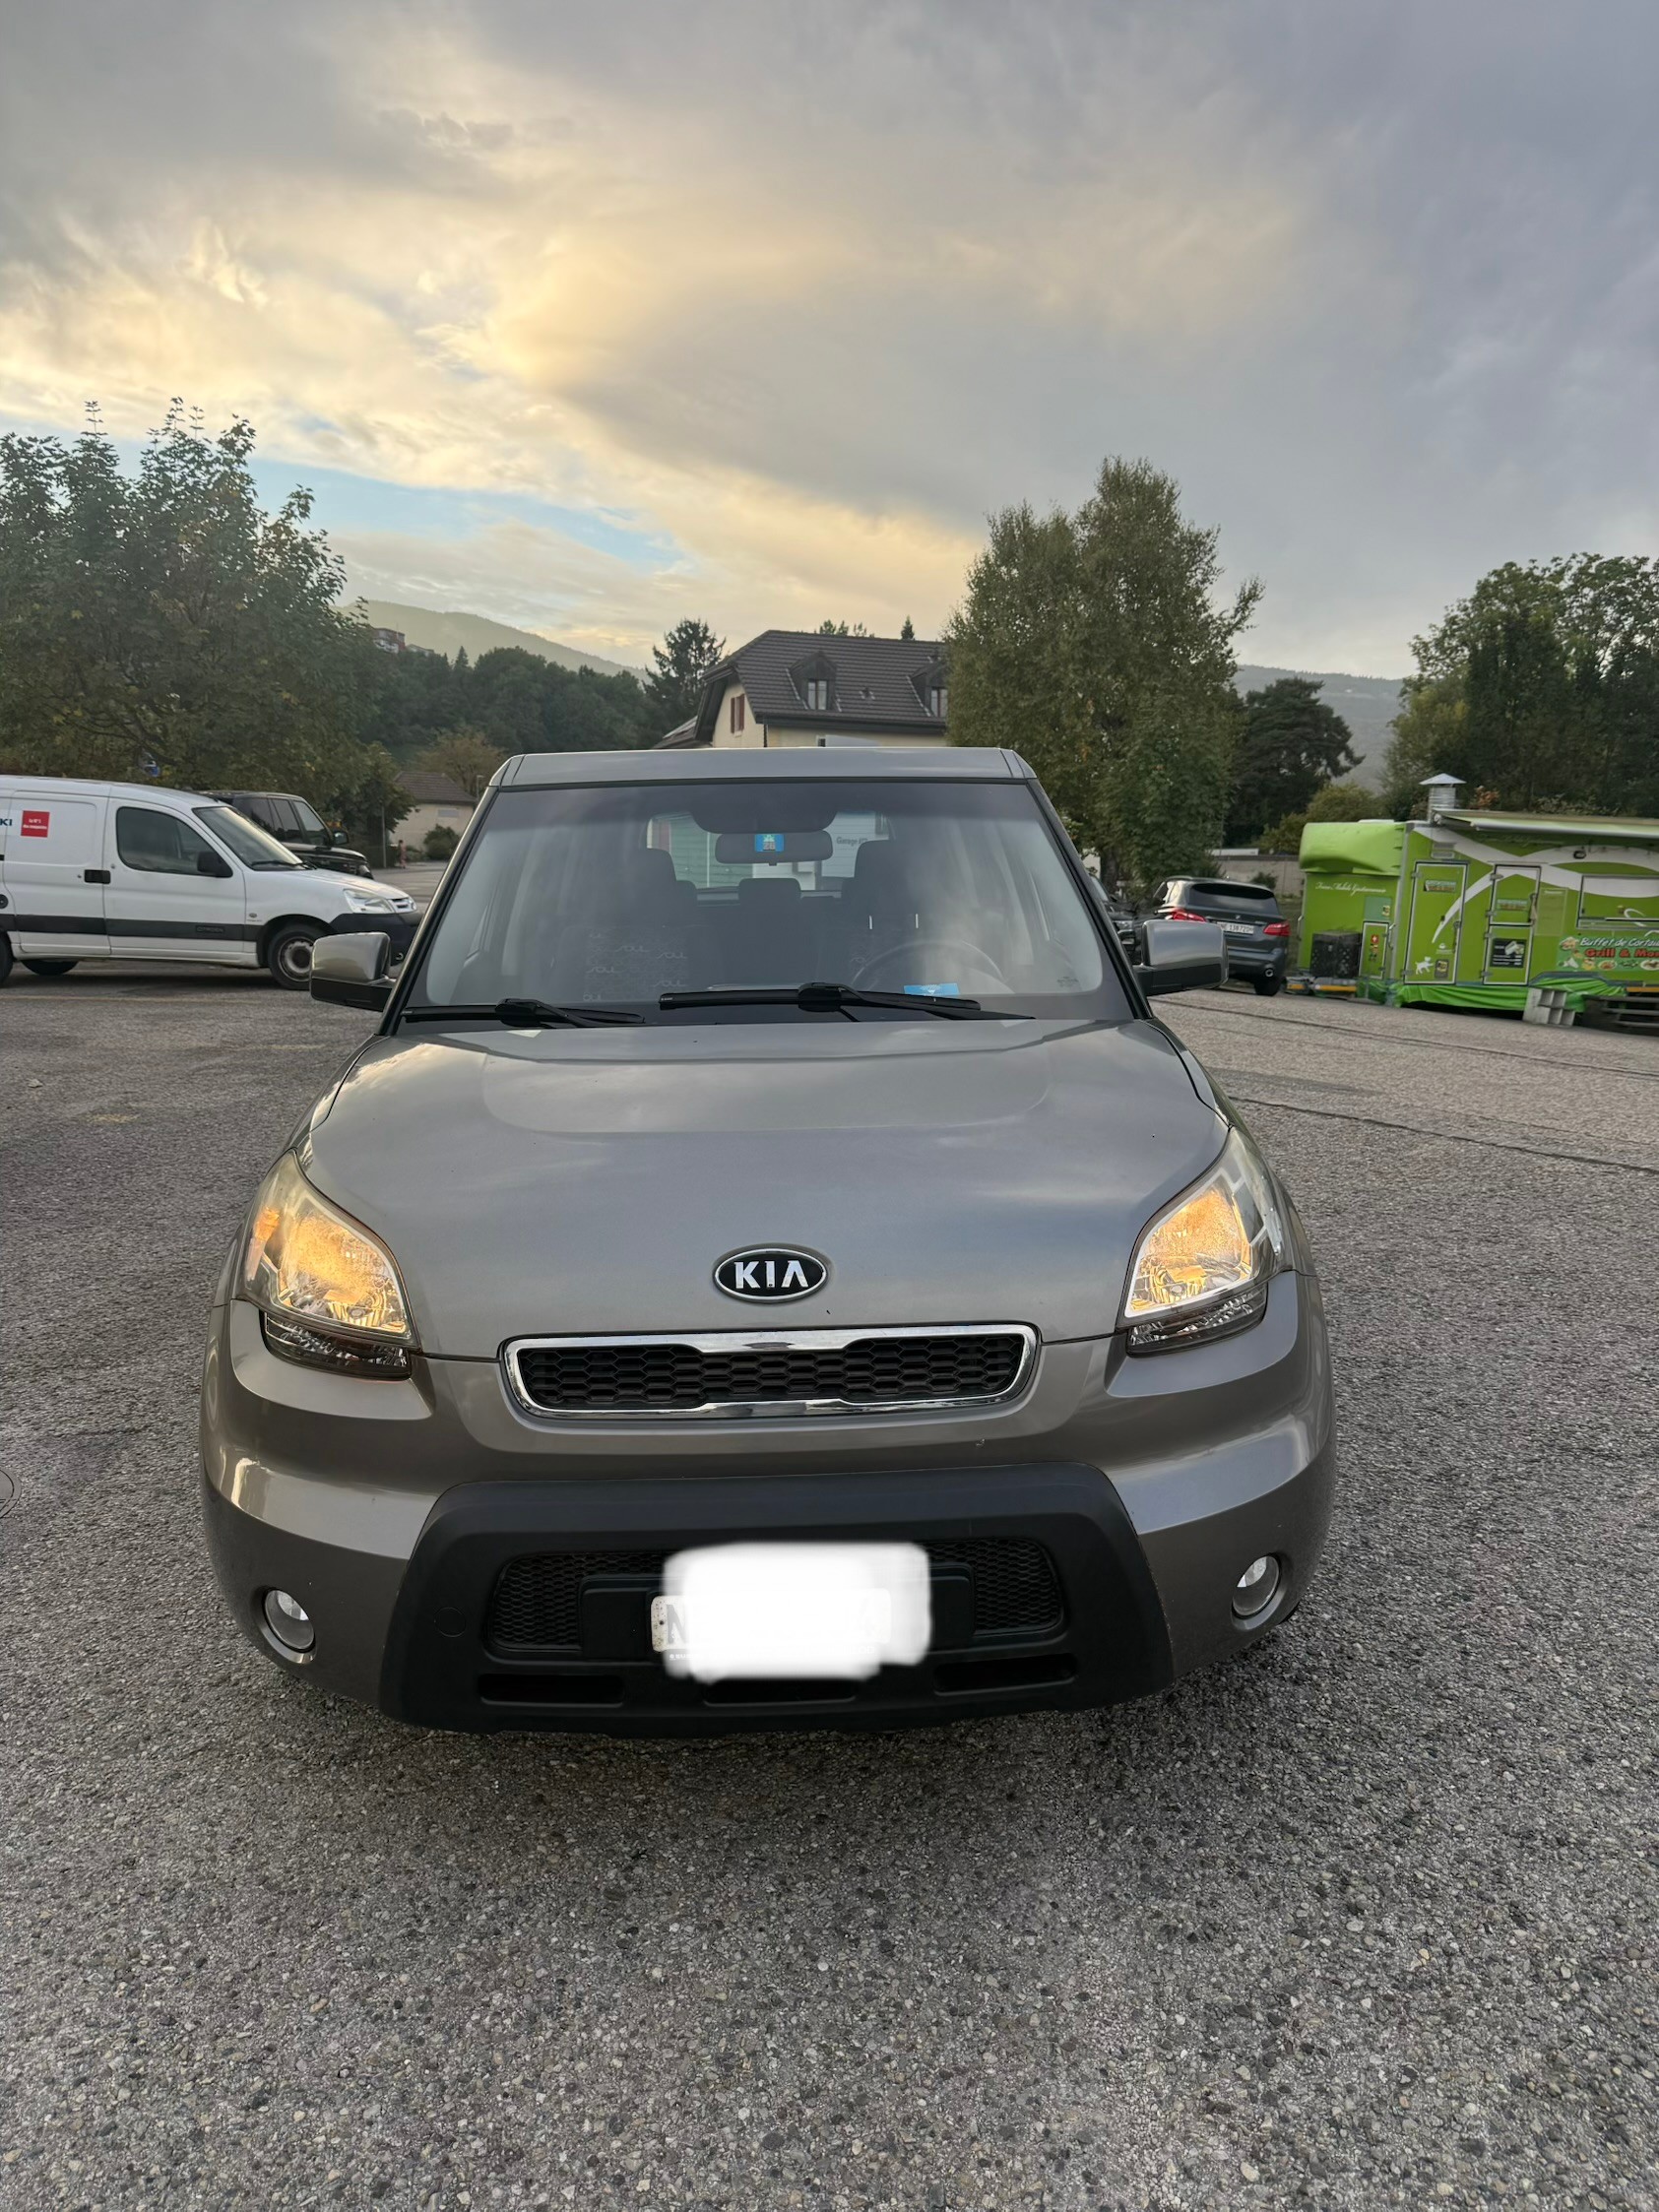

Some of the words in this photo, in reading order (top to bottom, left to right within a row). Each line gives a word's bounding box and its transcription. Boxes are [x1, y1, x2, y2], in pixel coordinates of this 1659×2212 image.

[1580, 937, 1613, 946] Buffet
[1615, 938, 1627, 947] de
[1584, 948, 1616, 958] Grill
[1620, 948, 1630, 958] &
[734, 1260, 809, 1290] KIA
